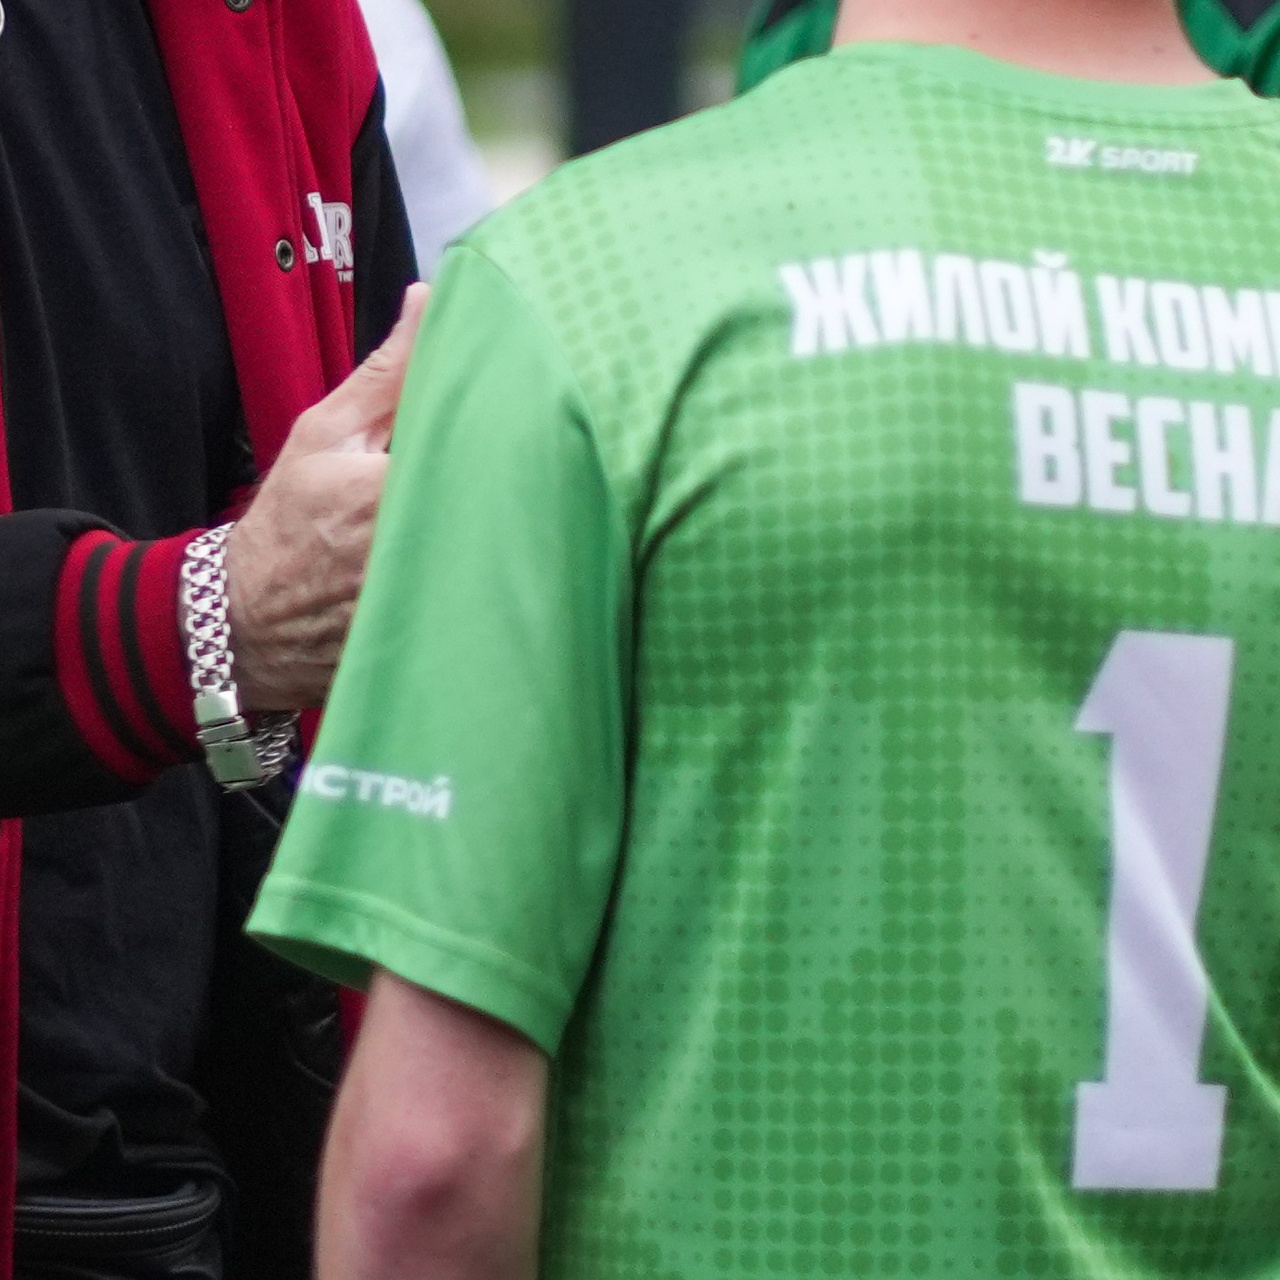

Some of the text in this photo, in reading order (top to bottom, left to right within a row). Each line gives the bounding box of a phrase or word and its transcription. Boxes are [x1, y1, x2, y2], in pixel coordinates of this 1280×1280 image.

[1101, 146, 1198, 175] SPORT
[779, 247, 1092, 357] ЖИЛОЙ
[1072, 630, 1235, 1190] 1
